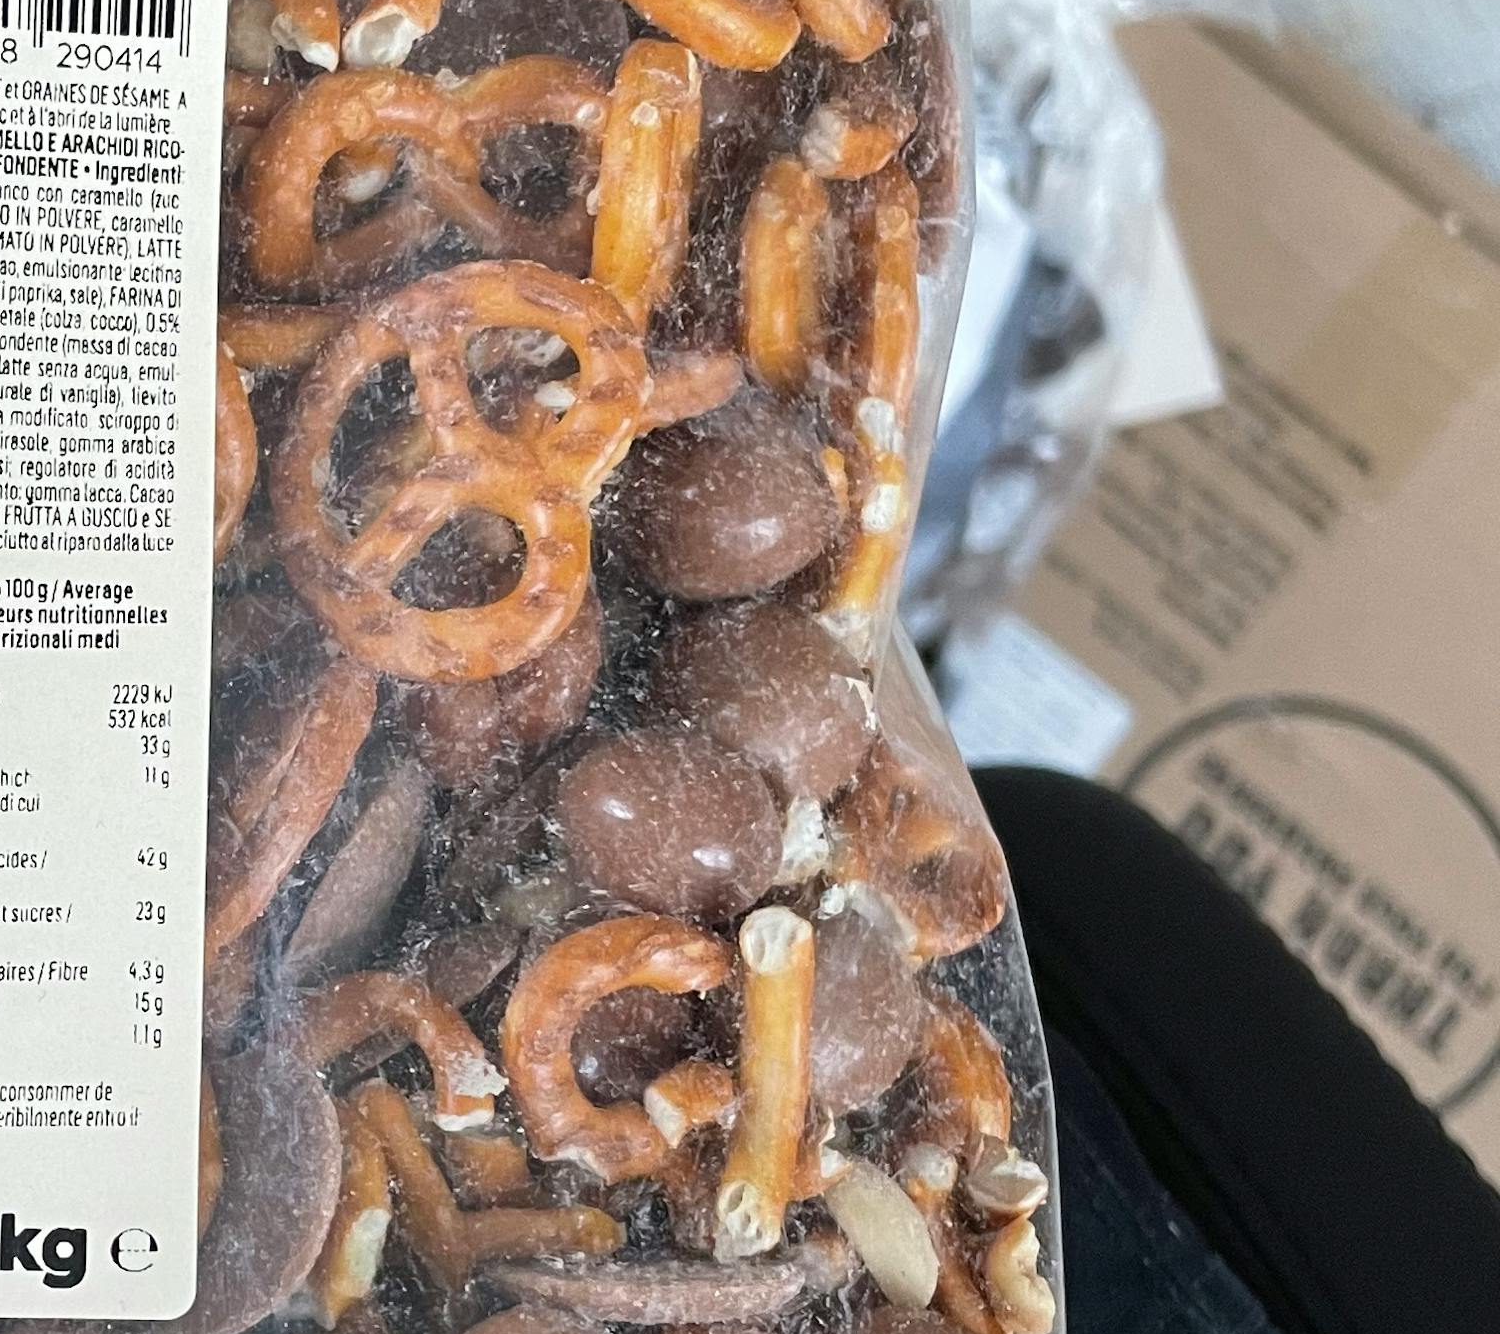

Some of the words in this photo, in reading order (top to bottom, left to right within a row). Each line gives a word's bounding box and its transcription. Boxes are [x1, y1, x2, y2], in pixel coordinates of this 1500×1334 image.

[56, 41, 161, 74] 290414
[61, 132, 138, 157] ARACHIDI
[143, 138, 185, 159] RICO-
[5, 577, 33, 598] 100
[37, 583, 48, 603] g
[62, 579, 133, 604] Average
[38, 603, 167, 624] nutritionnelles
[77, 628, 119, 649] medi
[112, 684, 149, 704] 2229
[154, 684, 172, 703] kJ
[107, 708, 135, 728] 532
[140, 709, 171, 728] kcal
[11, 906, 62, 922] sucres
[135, 900, 153, 921] 23
[48, 960, 87, 981] Fibre
